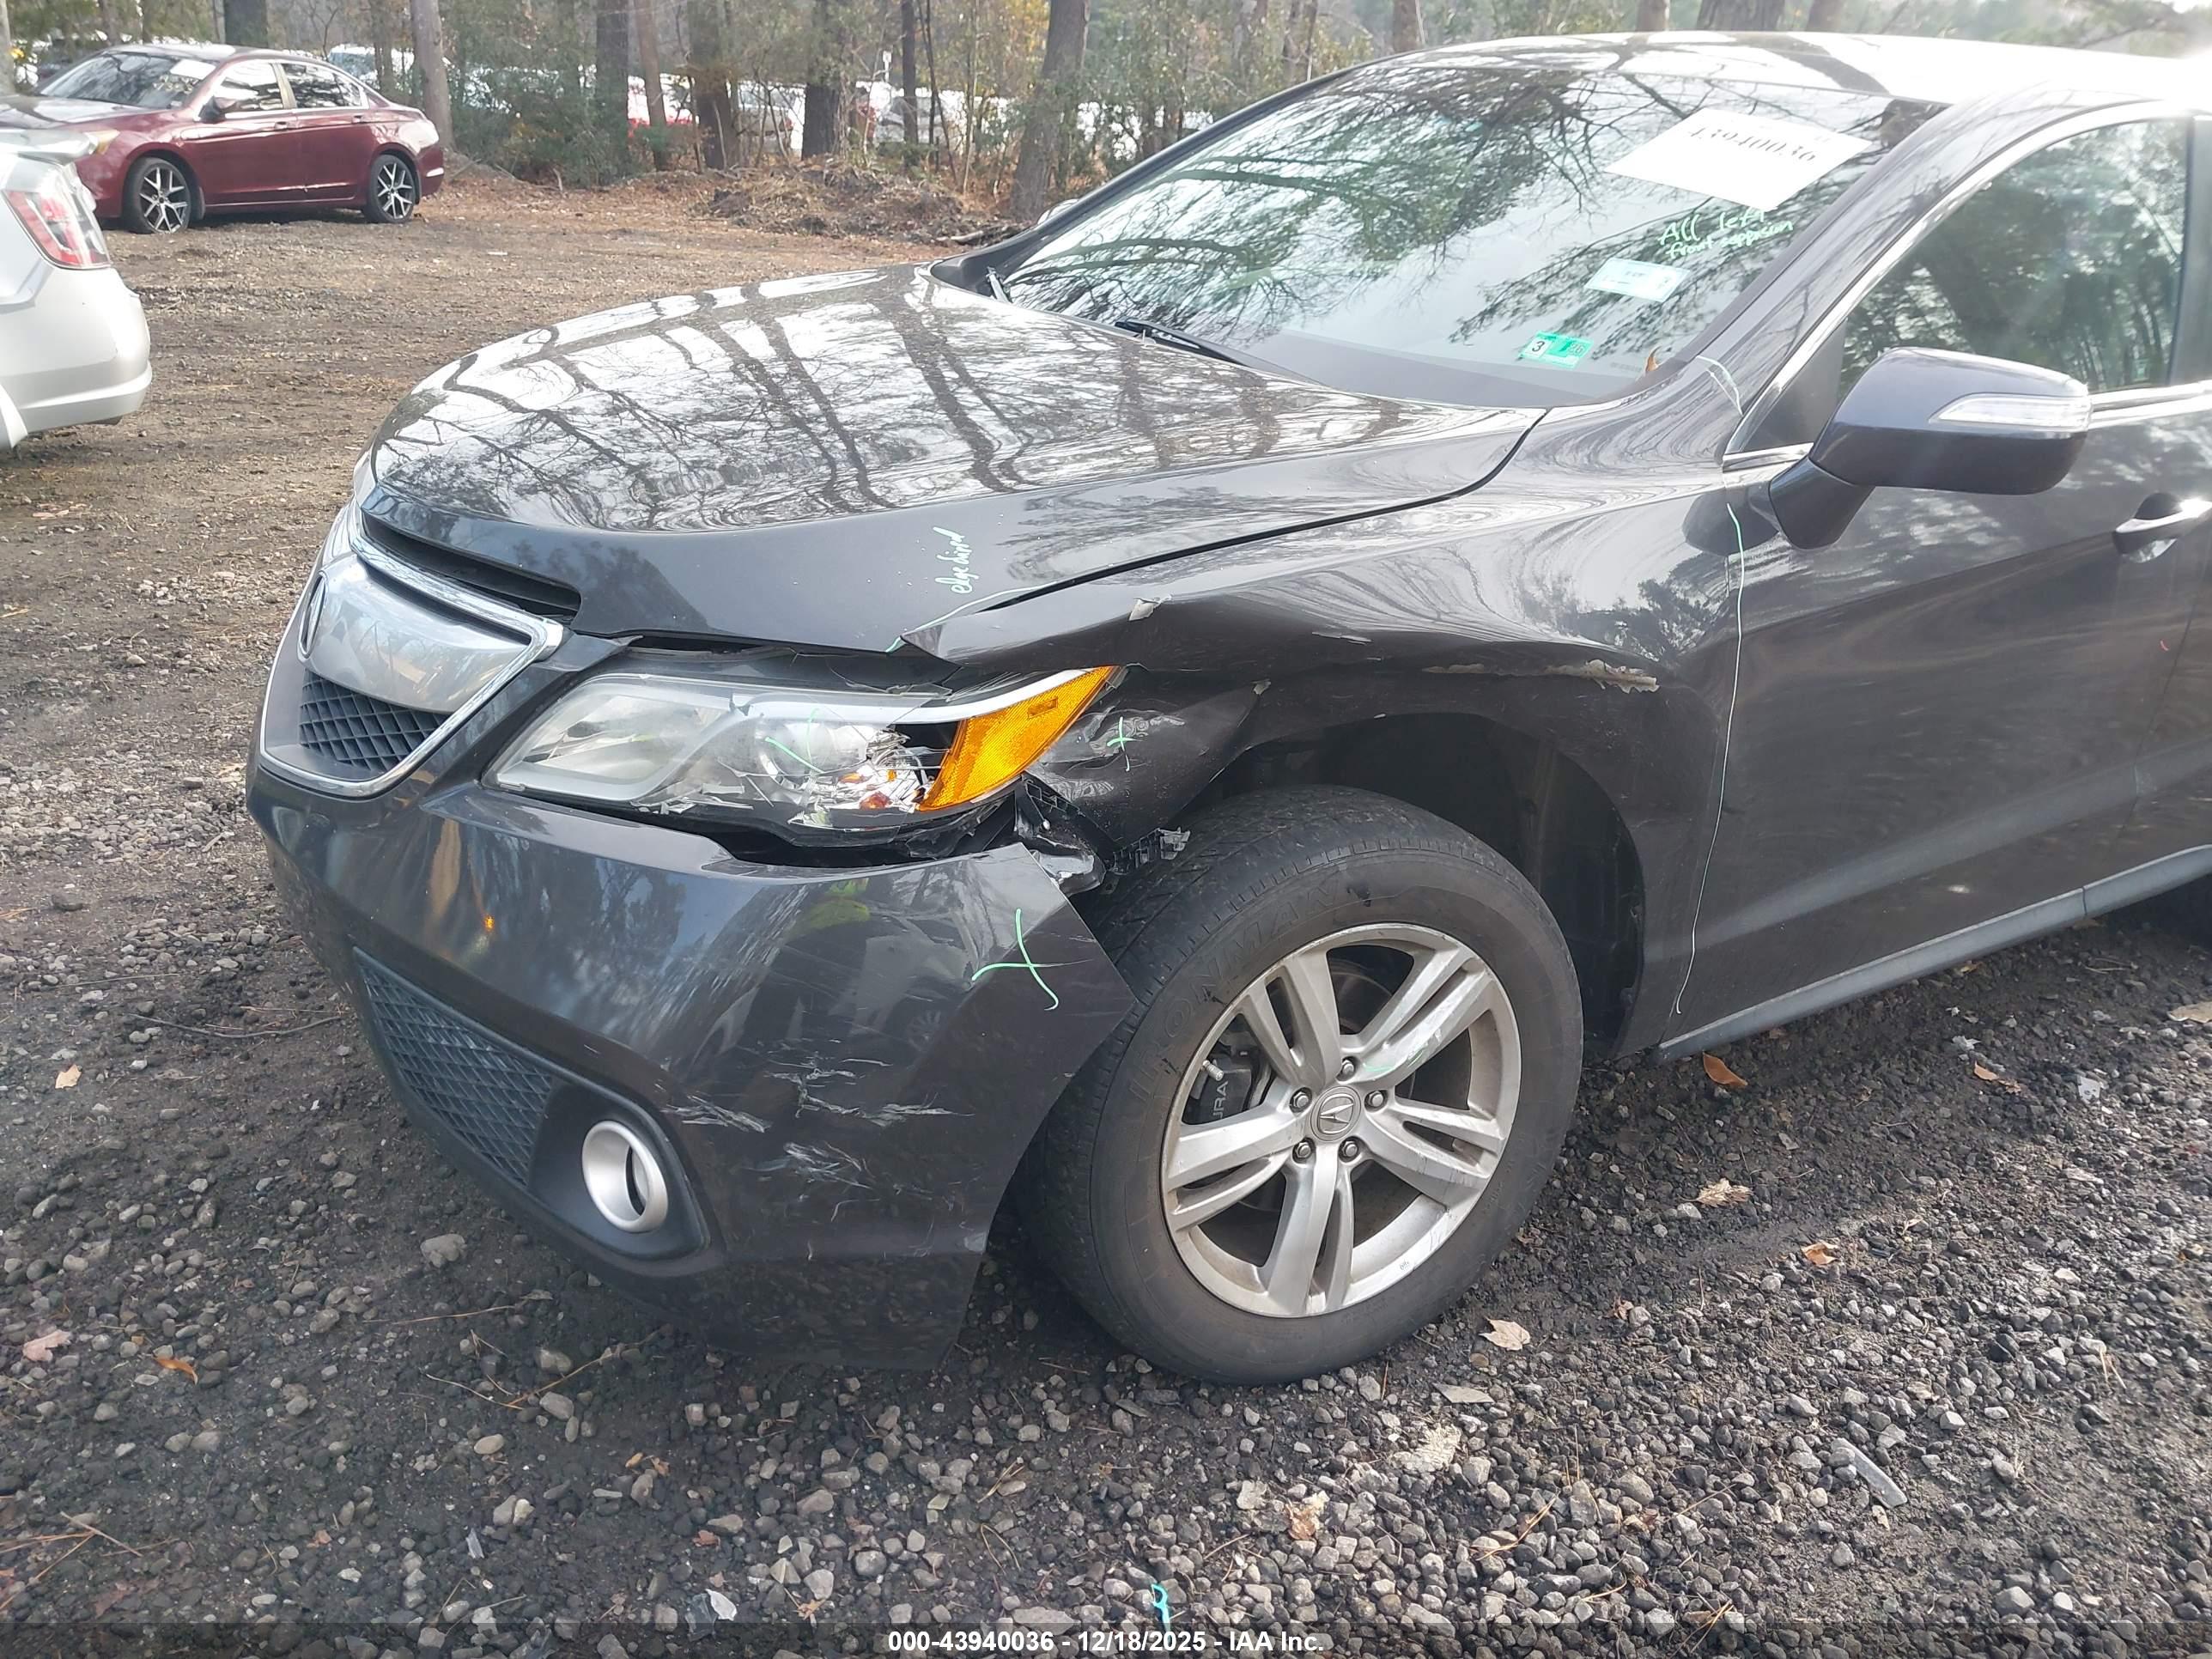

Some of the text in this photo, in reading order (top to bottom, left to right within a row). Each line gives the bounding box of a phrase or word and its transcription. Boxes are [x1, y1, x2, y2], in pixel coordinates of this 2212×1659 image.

[1657, 214, 1700, 246] All
[1665, 234, 1714, 258] front
[1531, 340, 1545, 352] 3
[1212, 1081, 1229, 1120] URA
